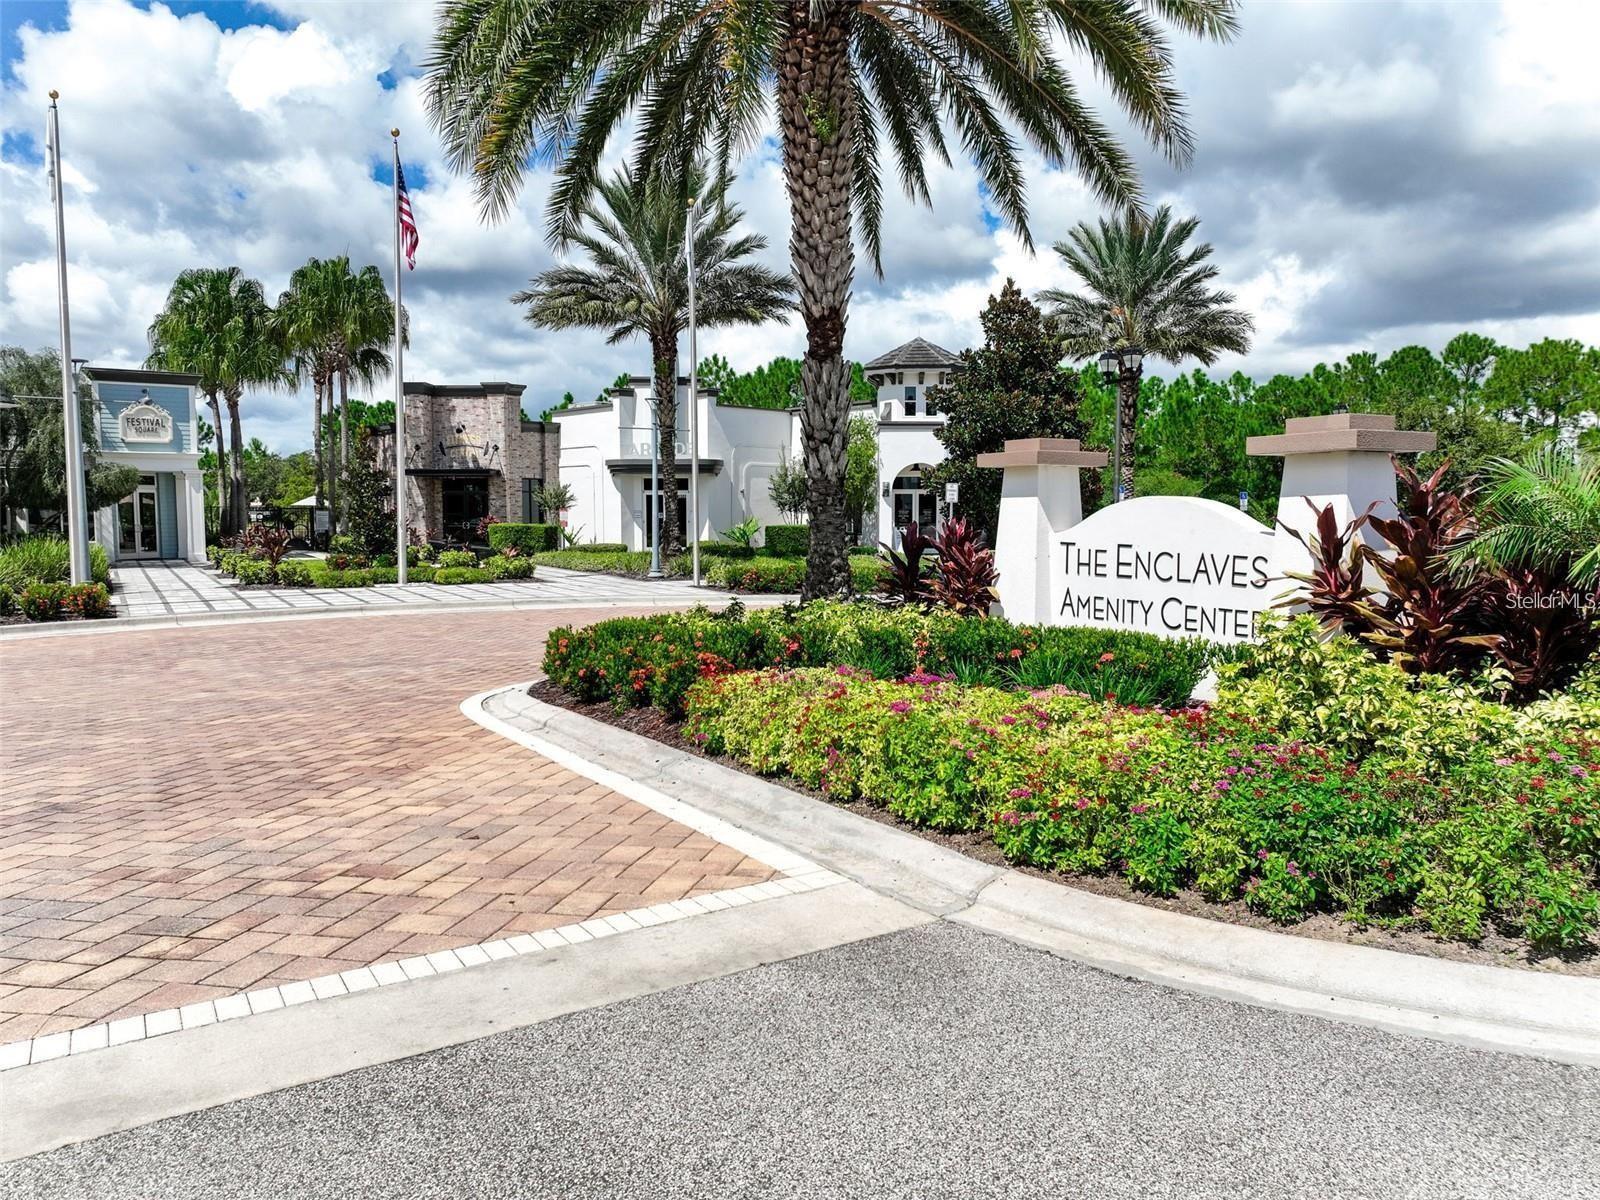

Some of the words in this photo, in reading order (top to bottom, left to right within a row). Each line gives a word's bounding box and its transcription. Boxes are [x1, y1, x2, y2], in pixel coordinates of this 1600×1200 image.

[126, 417, 166, 428] FESTIVAL
[1060, 541, 1107, 577] THE
[1116, 543, 1269, 589] ENCLAVES
[1060, 586, 1154, 626] AMENITY
